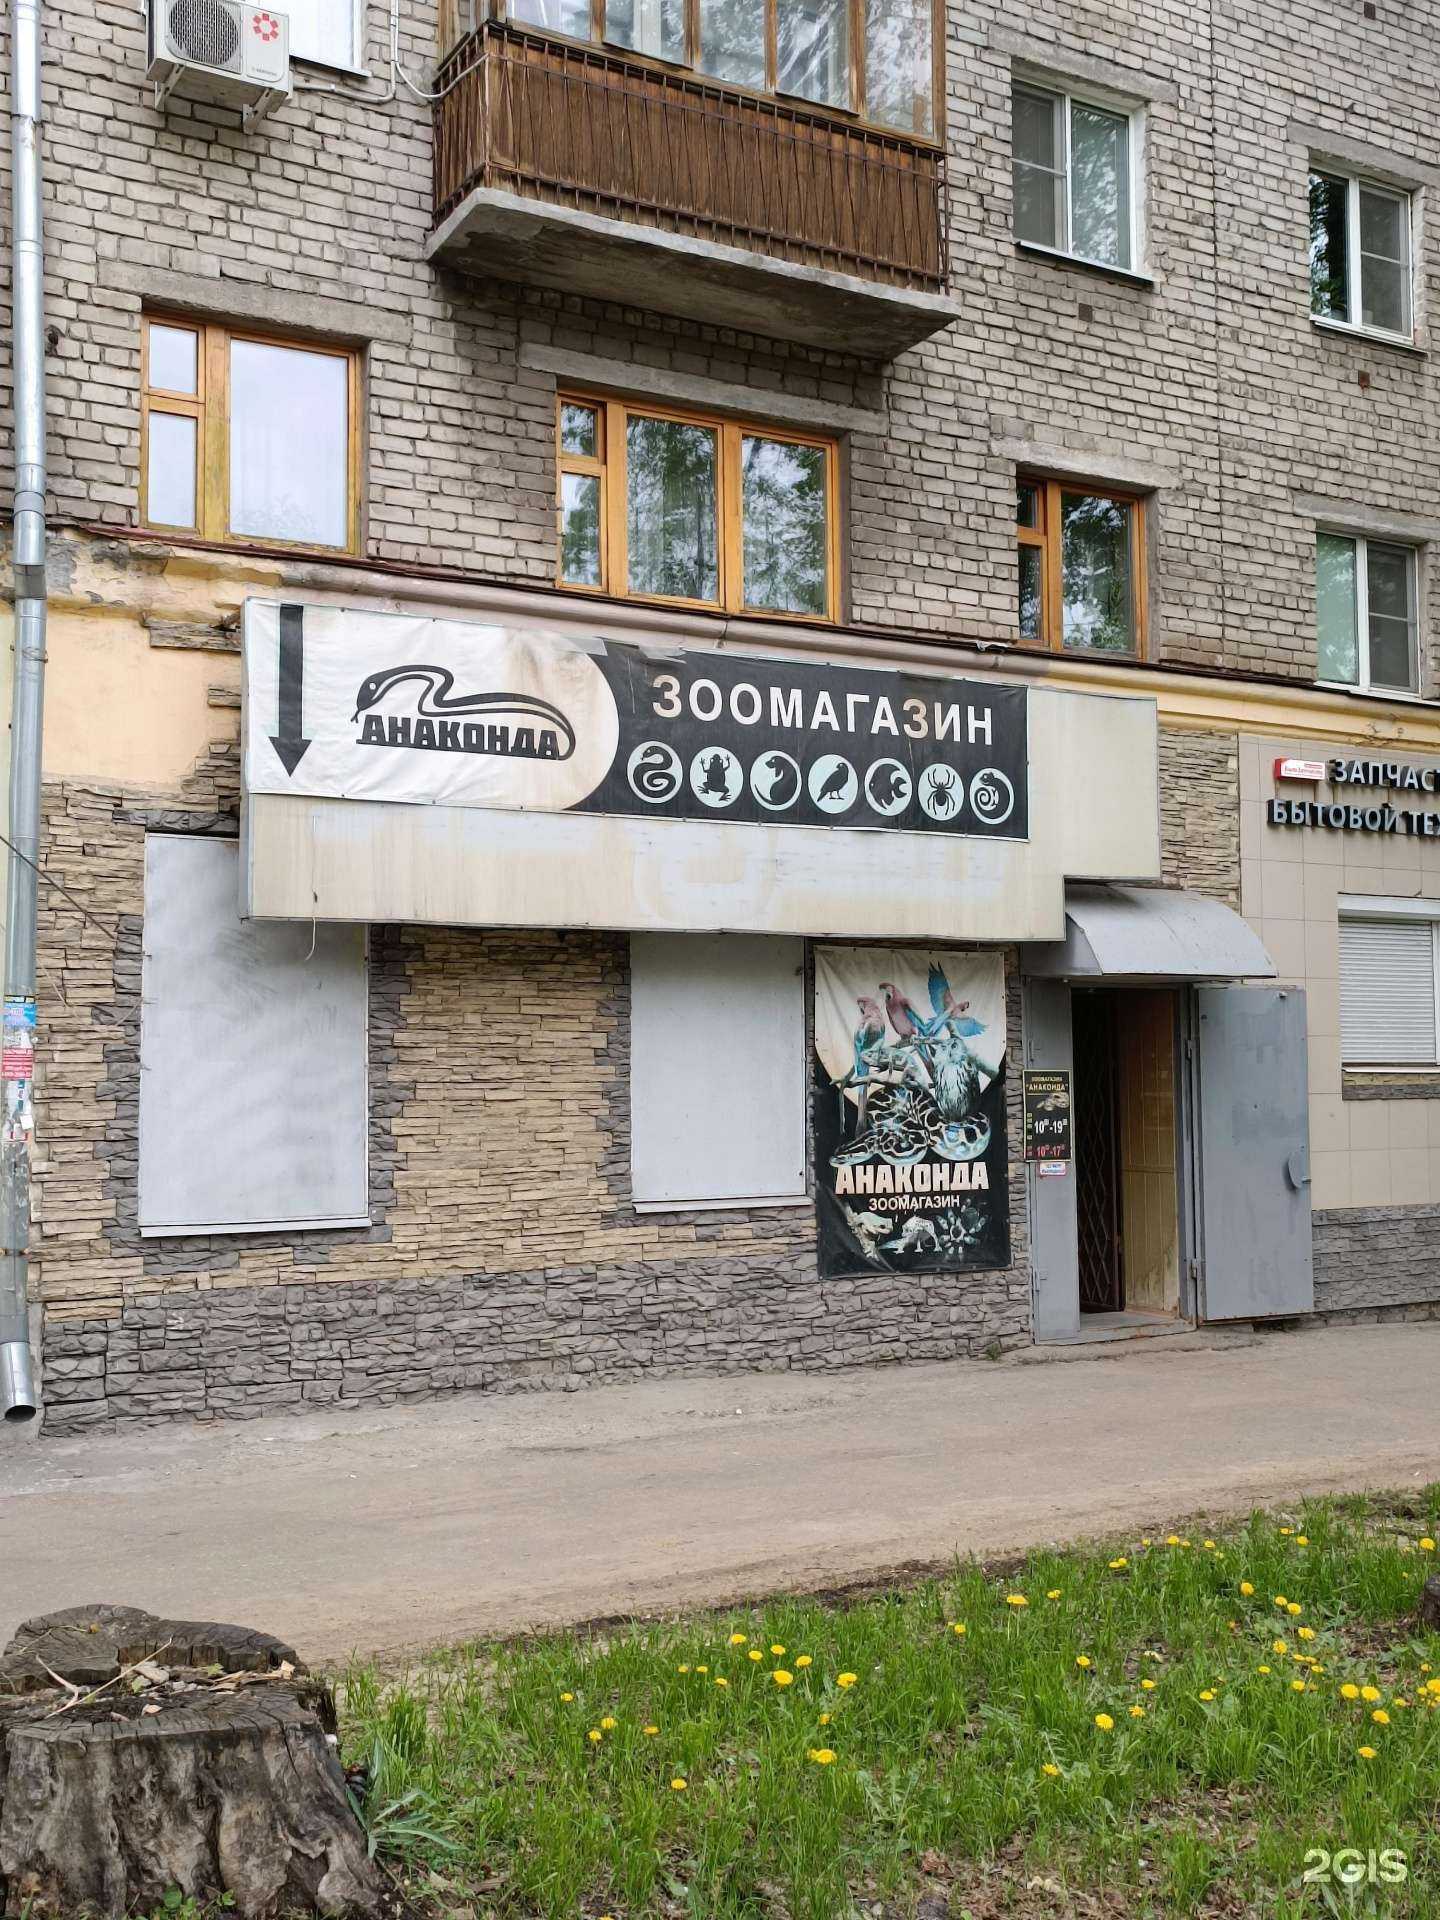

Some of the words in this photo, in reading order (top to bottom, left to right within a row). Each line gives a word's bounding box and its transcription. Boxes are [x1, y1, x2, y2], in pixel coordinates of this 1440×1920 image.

[651, 674, 994, 746] ЗООМАГАЗИН
[358, 714, 560, 760] АНАКОНДА
[1269, 799, 1399, 834] БЫТОВОЙ
[835, 1161, 990, 1195] АНАКОНДА
[868, 1194, 961, 1211] ЗООМАГАЗИН
